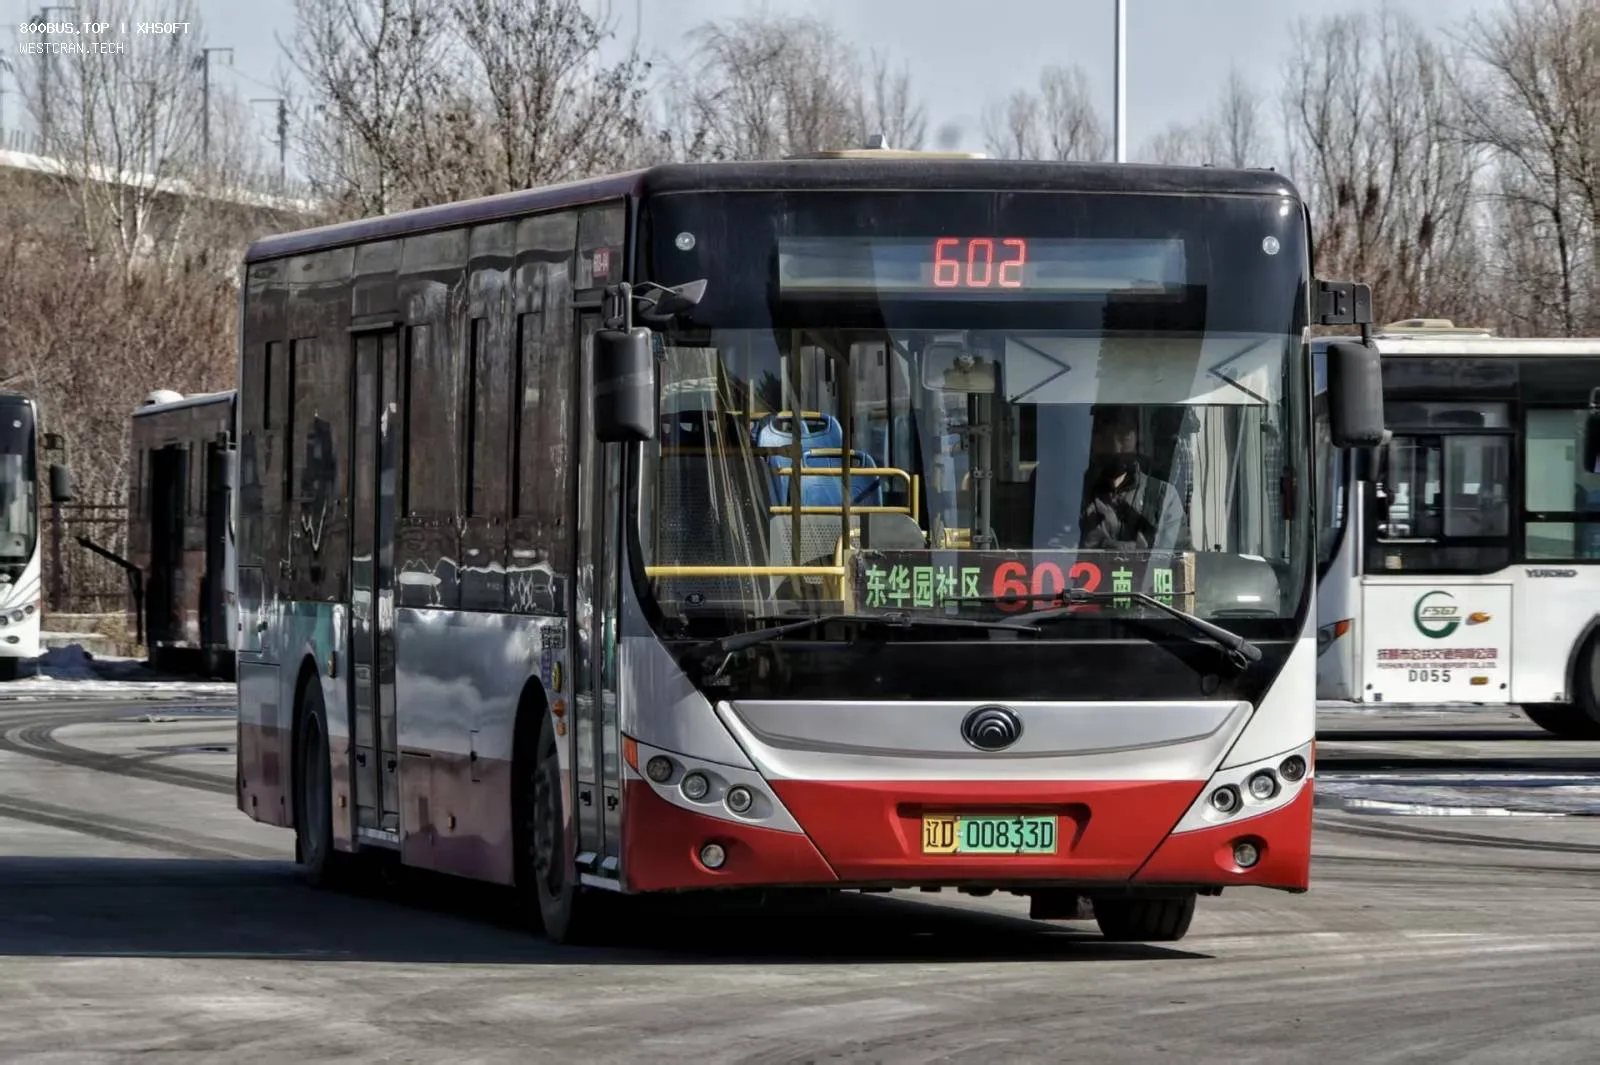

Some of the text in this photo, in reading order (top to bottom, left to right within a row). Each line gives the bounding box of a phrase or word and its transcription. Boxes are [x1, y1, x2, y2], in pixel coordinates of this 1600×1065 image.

[934, 238, 1026, 288] 602
[865, 564, 982, 609] 东华园社区
[992, 561, 1102, 612] 602
[1408, 669, 1451, 682] D055
[926, 820, 1054, 848] 辽D 00833D
